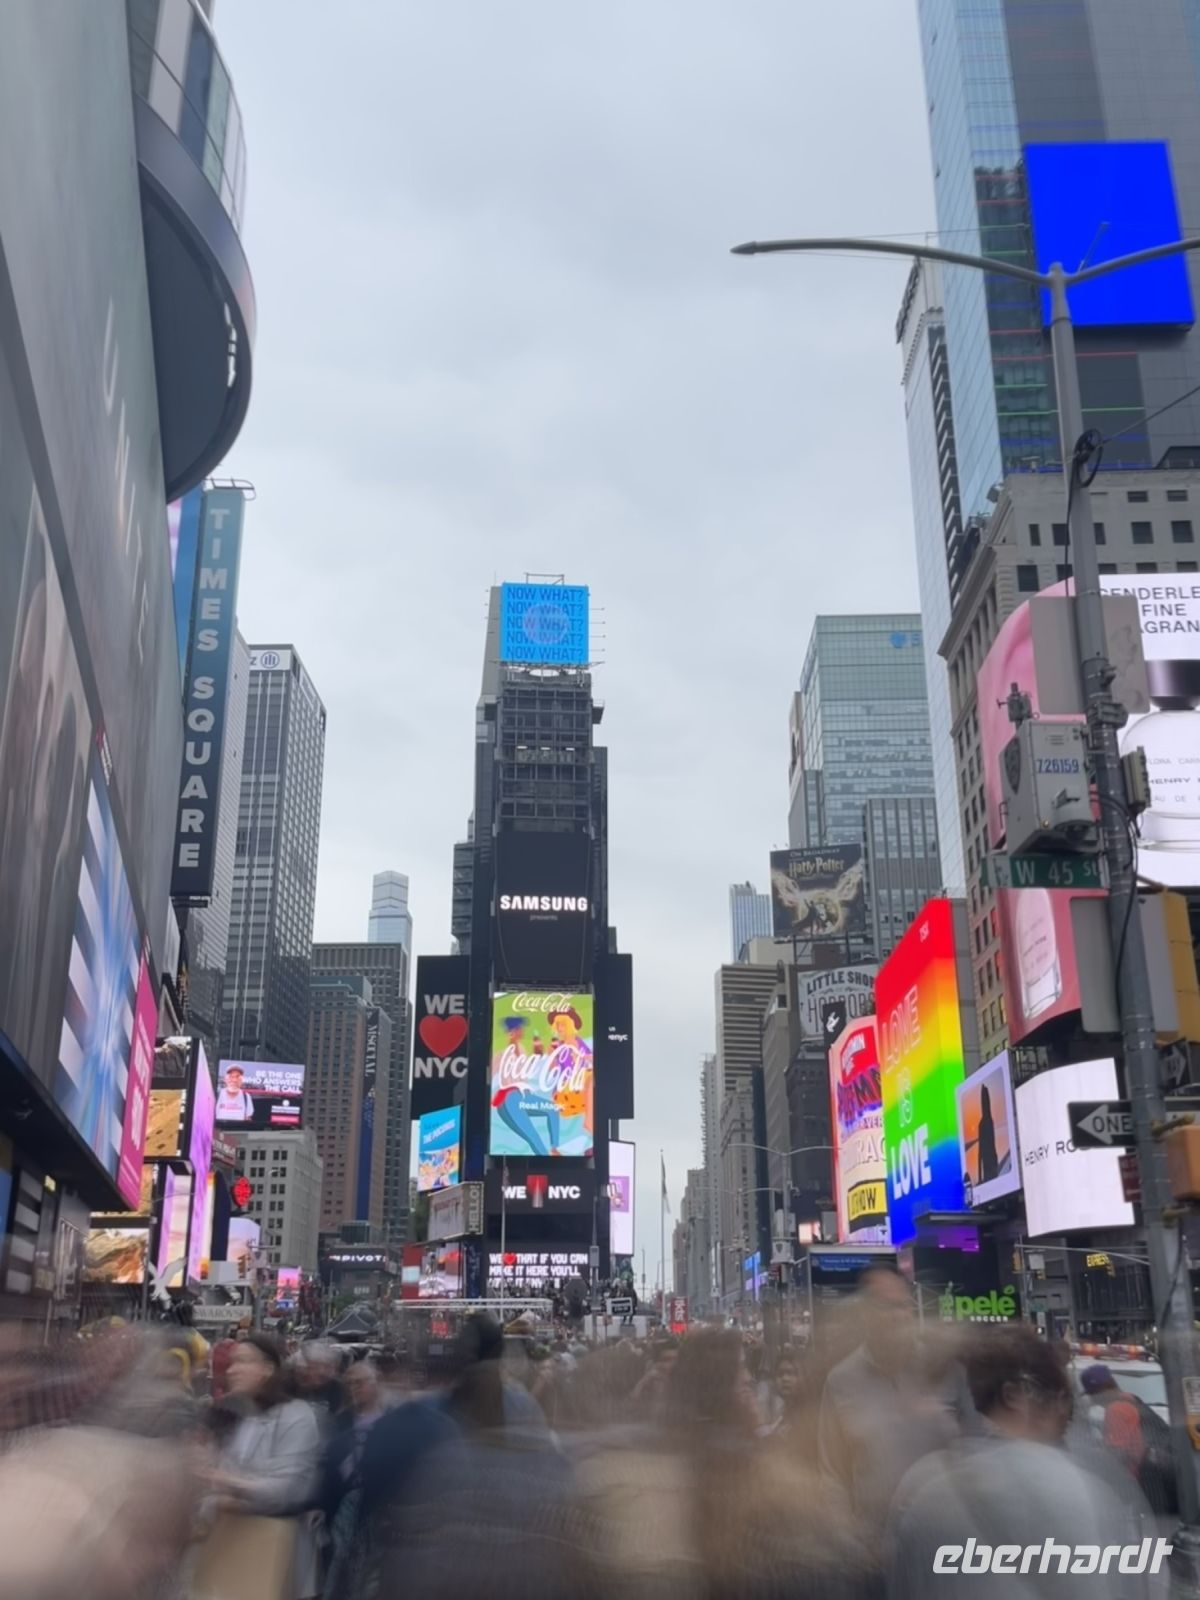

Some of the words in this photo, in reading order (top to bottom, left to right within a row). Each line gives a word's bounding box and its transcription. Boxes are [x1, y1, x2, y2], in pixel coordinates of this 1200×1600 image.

[197, 507, 231, 652] TIMES
[507, 587, 536, 600] NOW
[540, 588, 584, 602] WHAT?
[1141, 604, 1187, 617] FINE
[1140, 620, 1200, 634] GRAN
[507, 645, 536, 659] NOW
[540, 646, 584, 661] WHAT?
[177, 675, 217, 869] SQUARE
[1036, 757, 1080, 774] 726159
[789, 859, 815, 878] Harry
[815, 856, 845, 873] Potter
[1015, 860, 1036, 884] W
[1048, 860, 1074, 885] 45
[500, 895, 588, 911] SAMSUNG
[807, 971, 846, 995] LITTLE
[424, 994, 465, 1015] WE
[256, 1070, 267, 1078] BE
[268, 1071, 283, 1079] THE
[285, 1071, 303, 1080] ONE
[414, 1056, 469, 1079] NYC
[263, 1078, 302, 1087] ANSWERS
[282, 1086, 302, 1095] CALL
[518, 1102, 539, 1111] Real
[1092, 1115, 1133, 1133] ONE
[890, 1122, 932, 1201] LOVE
[1024, 1144, 1050, 1167] HENRY
[502, 1185, 527, 1199] WE
[549, 1185, 581, 1199] NYC
[489, 1252, 504, 1264] WE
[517, 1253, 539, 1264] THAT
[540, 1253, 550, 1264] IF
[551, 1253, 568, 1264] YOU
[570, 1253, 588, 1265] CAN
[489, 1265, 514, 1277] MAKE
[515, 1265, 525, 1277] IT
[526, 1265, 549, 1277] HERE
[550, 1265, 581, 1277] YOU'LL
[970, 1315, 1009, 1323] SOCCER
